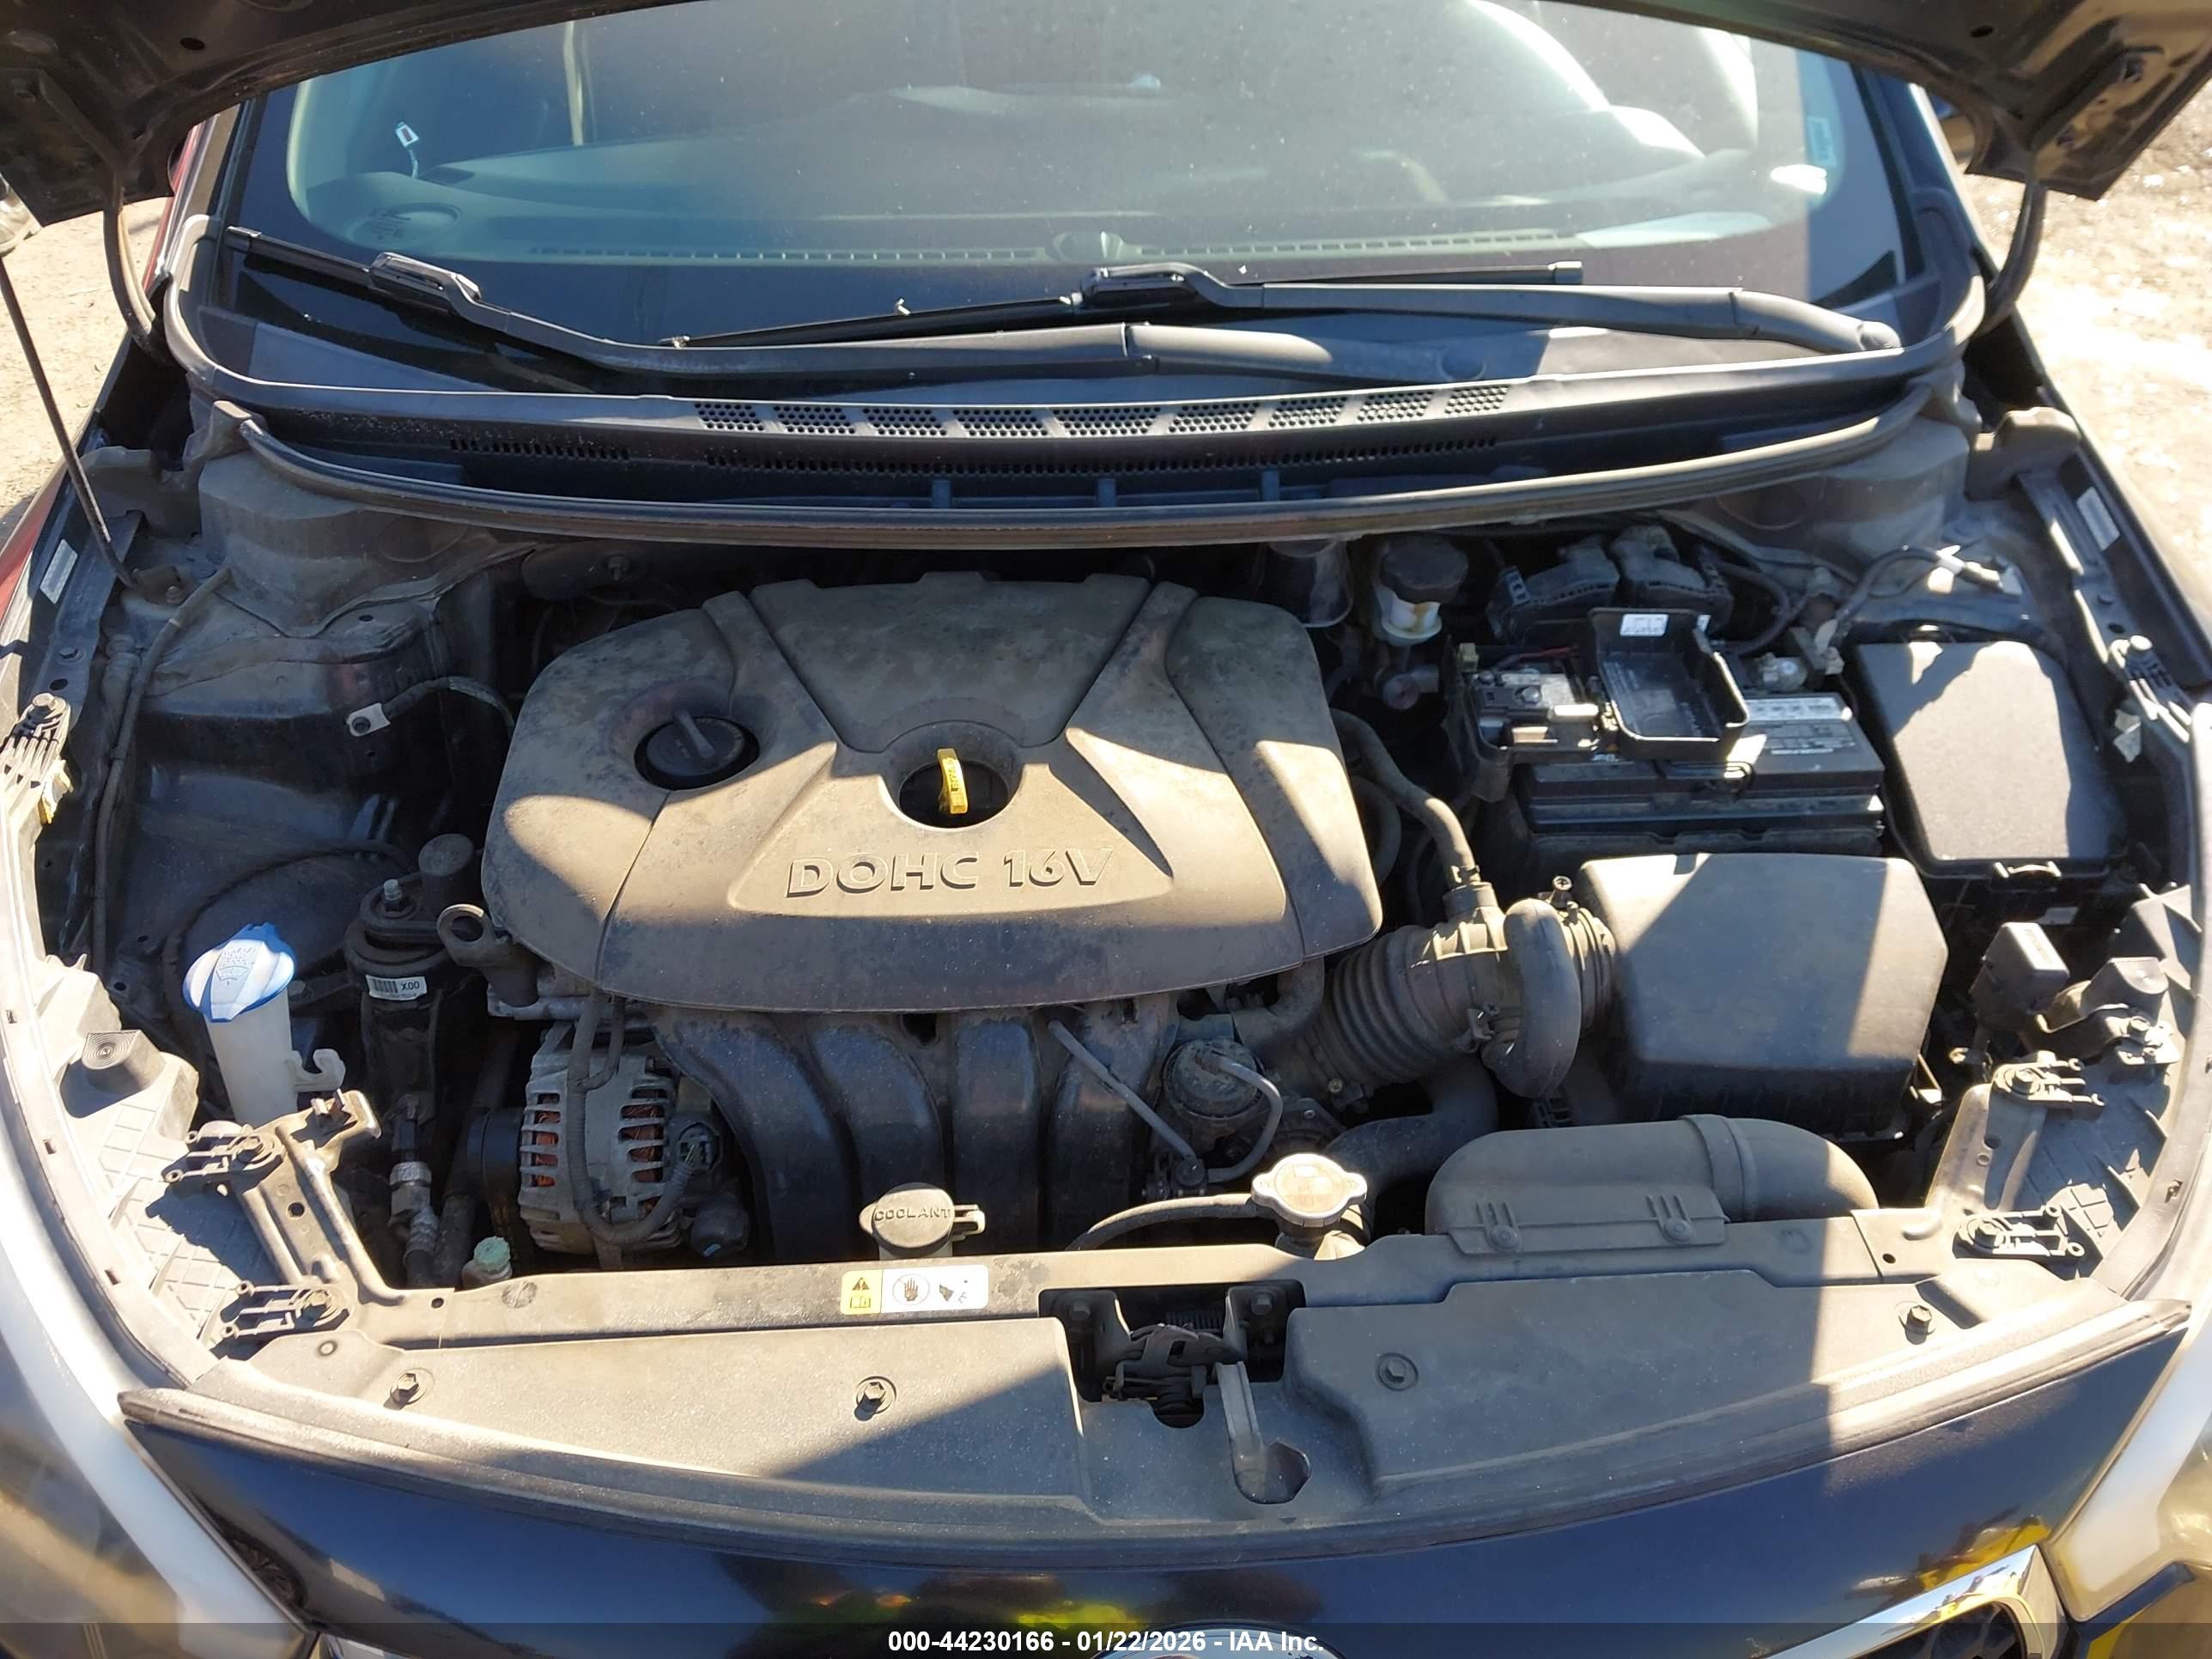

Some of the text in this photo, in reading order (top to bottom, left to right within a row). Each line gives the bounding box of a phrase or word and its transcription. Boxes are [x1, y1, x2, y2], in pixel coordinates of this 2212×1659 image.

[787, 847, 1114, 898] DOHC 16V
[874, 1207, 951, 1222] COOLANT
